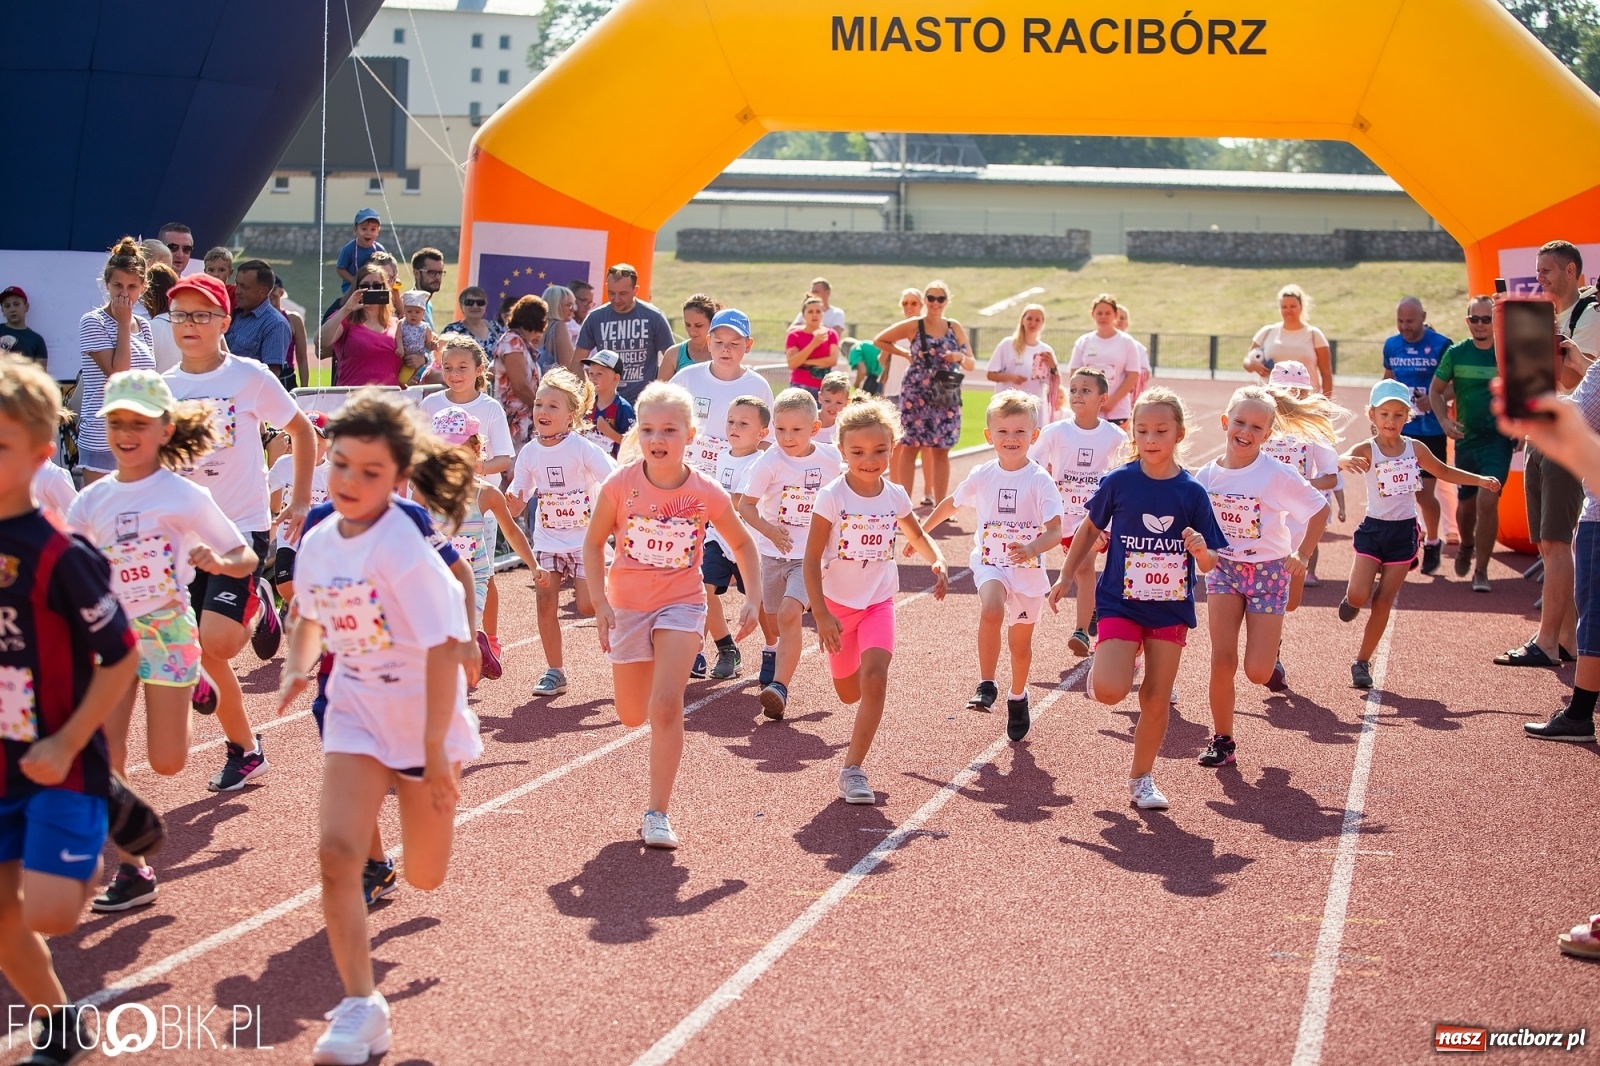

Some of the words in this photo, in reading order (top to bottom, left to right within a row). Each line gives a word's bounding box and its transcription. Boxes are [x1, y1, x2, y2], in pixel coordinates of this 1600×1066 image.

[831, 16, 1006, 52] MIASTO
[1023, 10, 1267, 55] RACIBÓRZ
[600, 319, 649, 340] VENICE
[620, 351, 647, 363] NGELES
[1392, 473, 1409, 483] 027
[556, 509, 575, 517] 046
[1221, 511, 1242, 524] 026
[647, 538, 674, 552] 019
[861, 534, 883, 545] 020
[1120, 535, 1187, 552] FRUTAVIT
[120, 565, 150, 583] 038
[1145, 572, 1170, 584] 006
